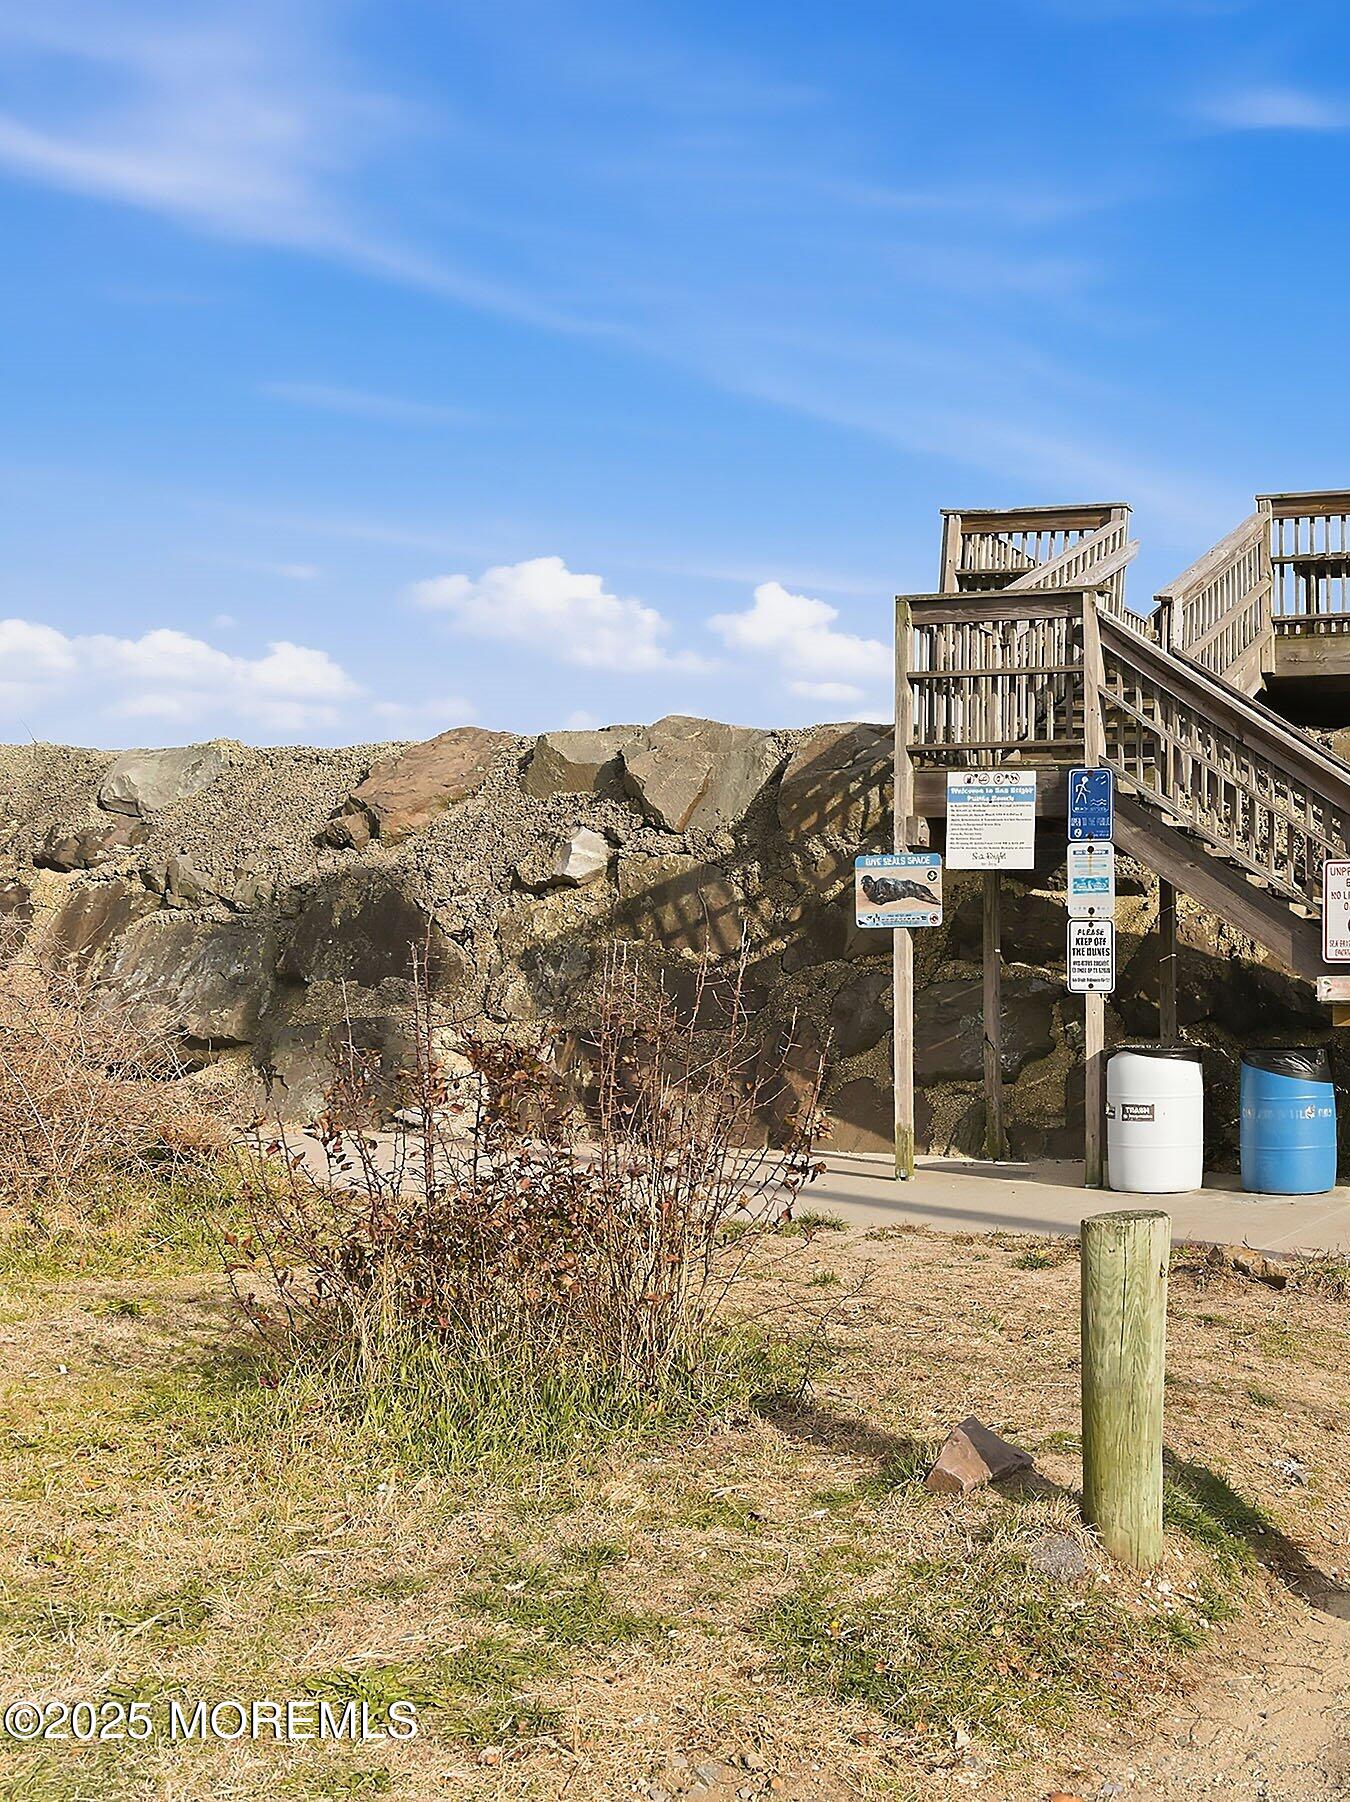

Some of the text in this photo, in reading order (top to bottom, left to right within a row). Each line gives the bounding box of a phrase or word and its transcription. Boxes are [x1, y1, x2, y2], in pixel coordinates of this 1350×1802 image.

[883, 857, 905, 865] SEALS
[907, 856, 930, 864] SPACE
[1331, 891, 1341, 900] NO
[1076, 937, 1106, 946] KEEP OFF
[1072, 948, 1110, 956] THE DUNES
